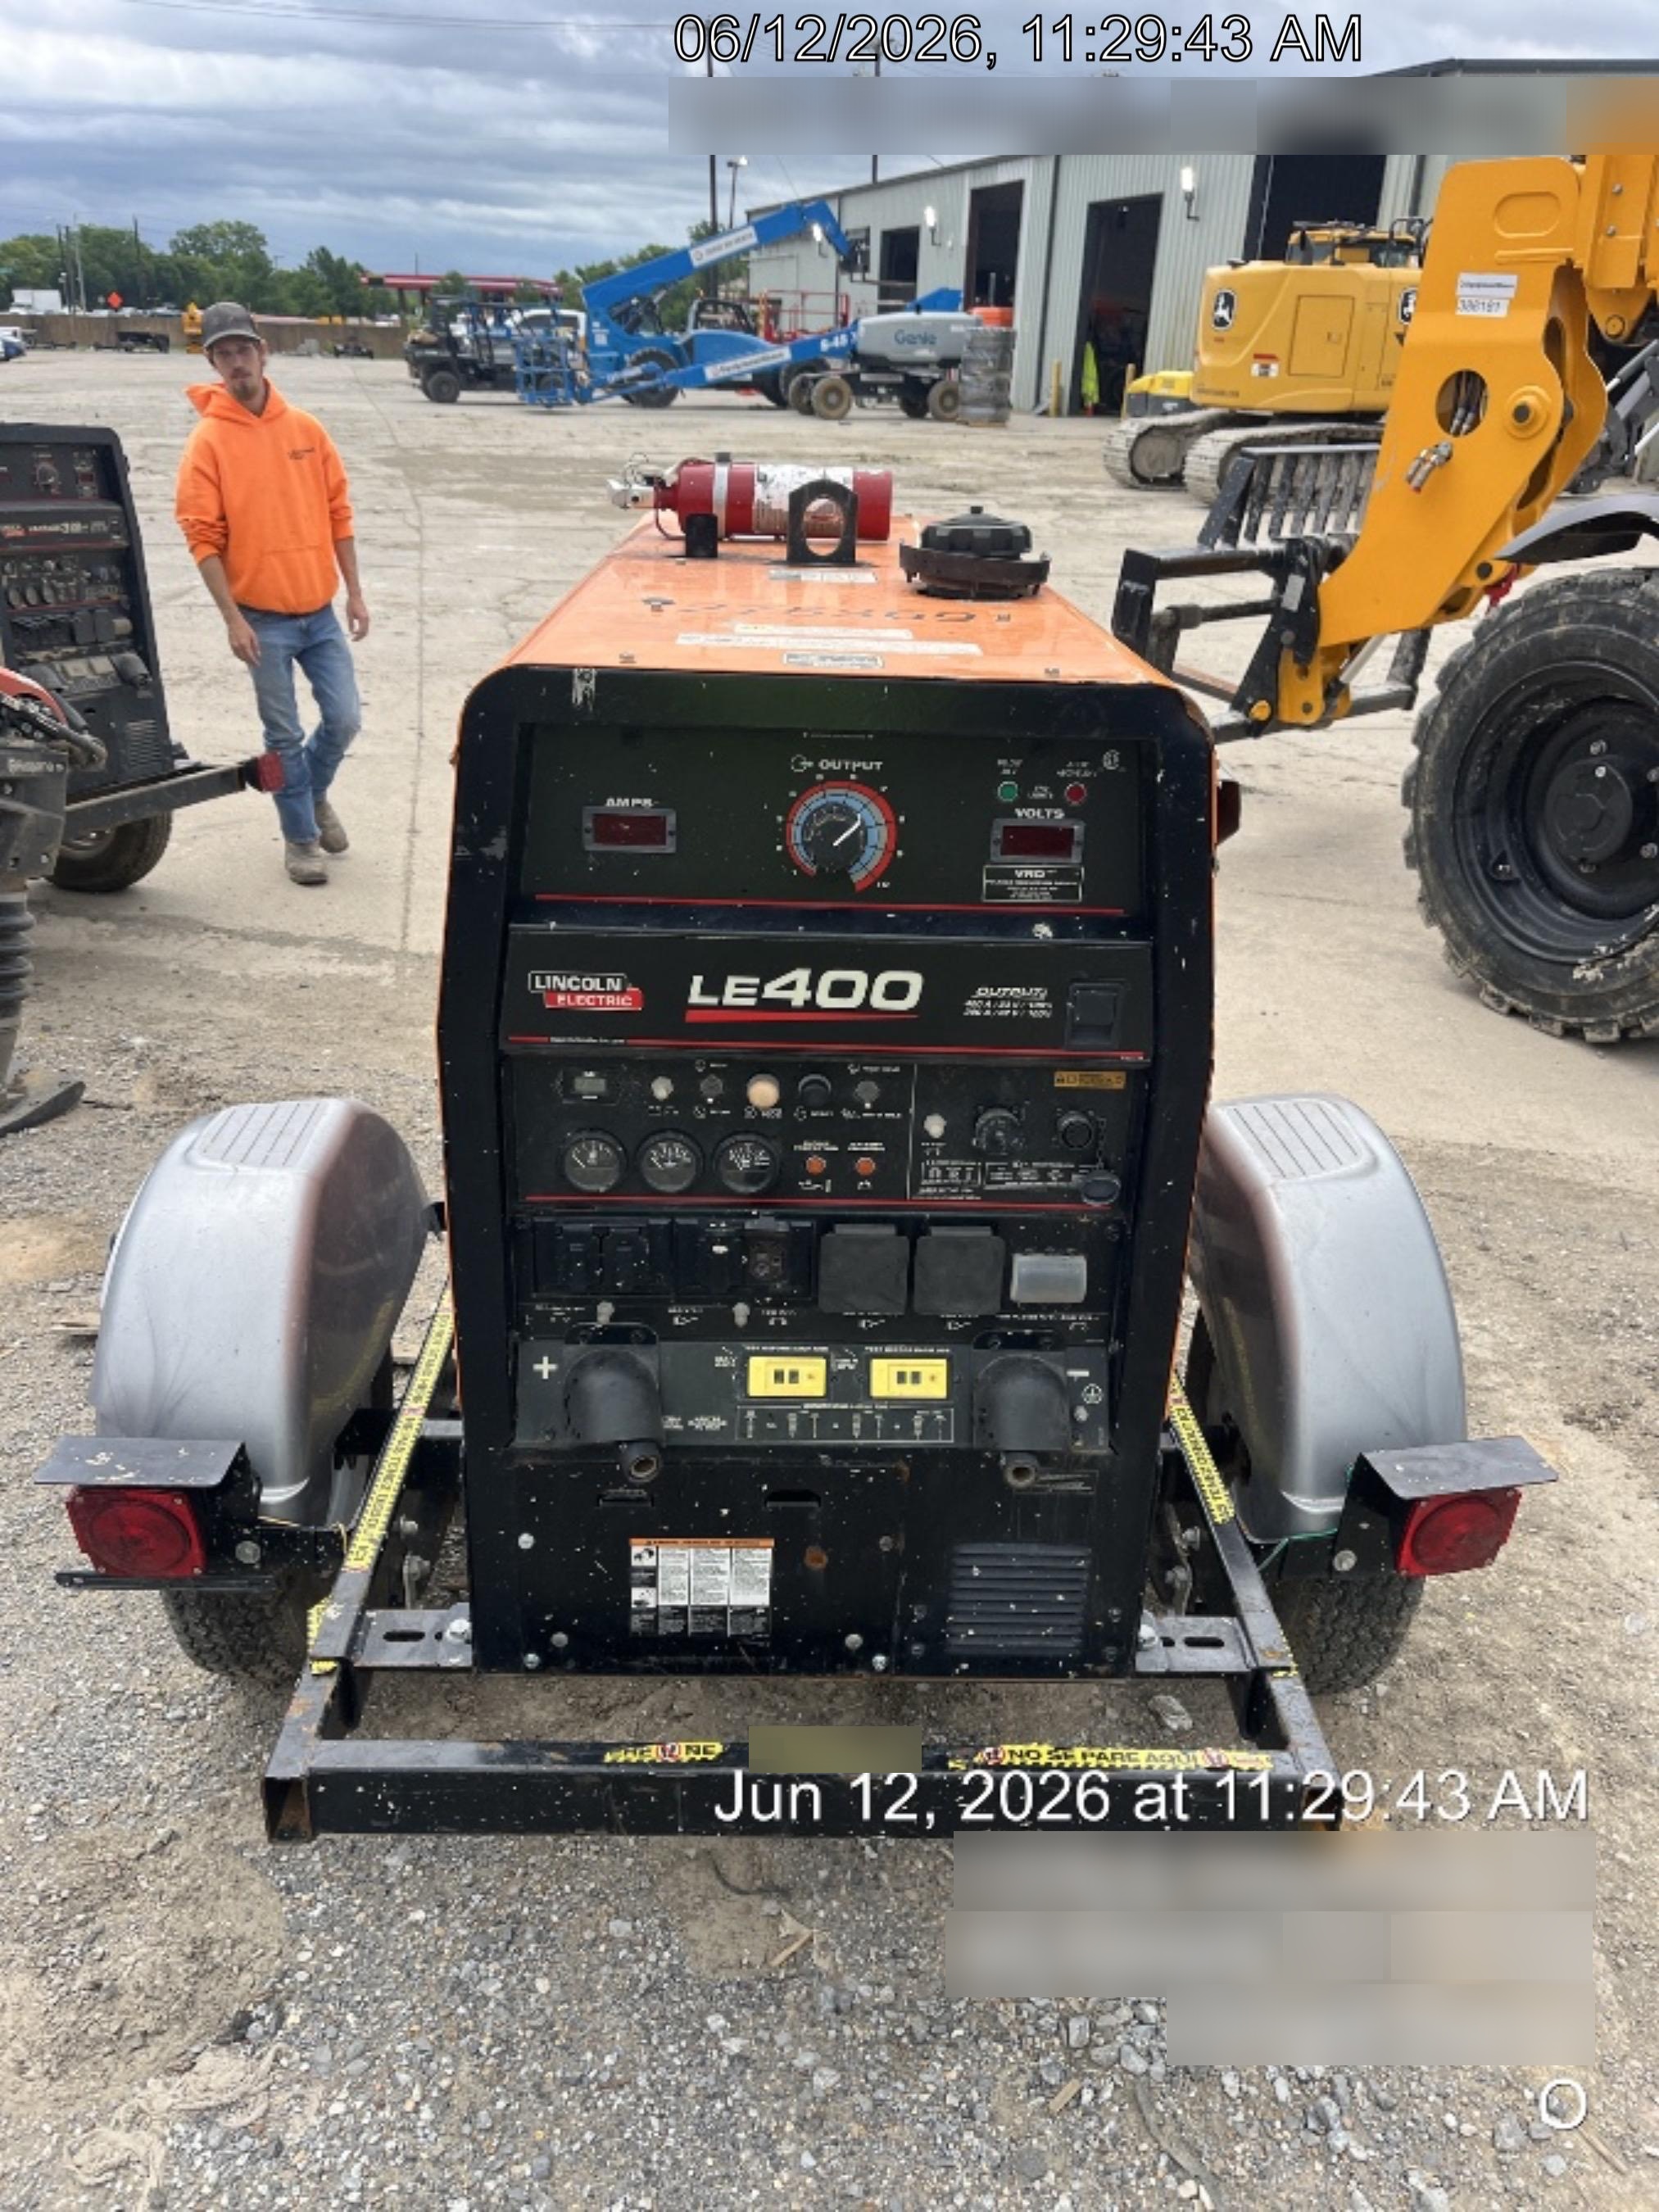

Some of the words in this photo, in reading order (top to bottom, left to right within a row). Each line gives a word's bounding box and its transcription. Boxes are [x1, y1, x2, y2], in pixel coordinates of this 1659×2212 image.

[894, 329, 937, 345] Genie
[818, 759, 883, 771] OUTPUT
[1015, 808, 1065, 819] VOLTS
[534, 975, 623, 991] LINCOLN
[687, 968, 924, 1011] LE400
[557, 994, 632, 1006] ELECTRIC
[1008, 1749, 1041, 1761] NO
[1081, 1751, 1140, 1762] PARE
